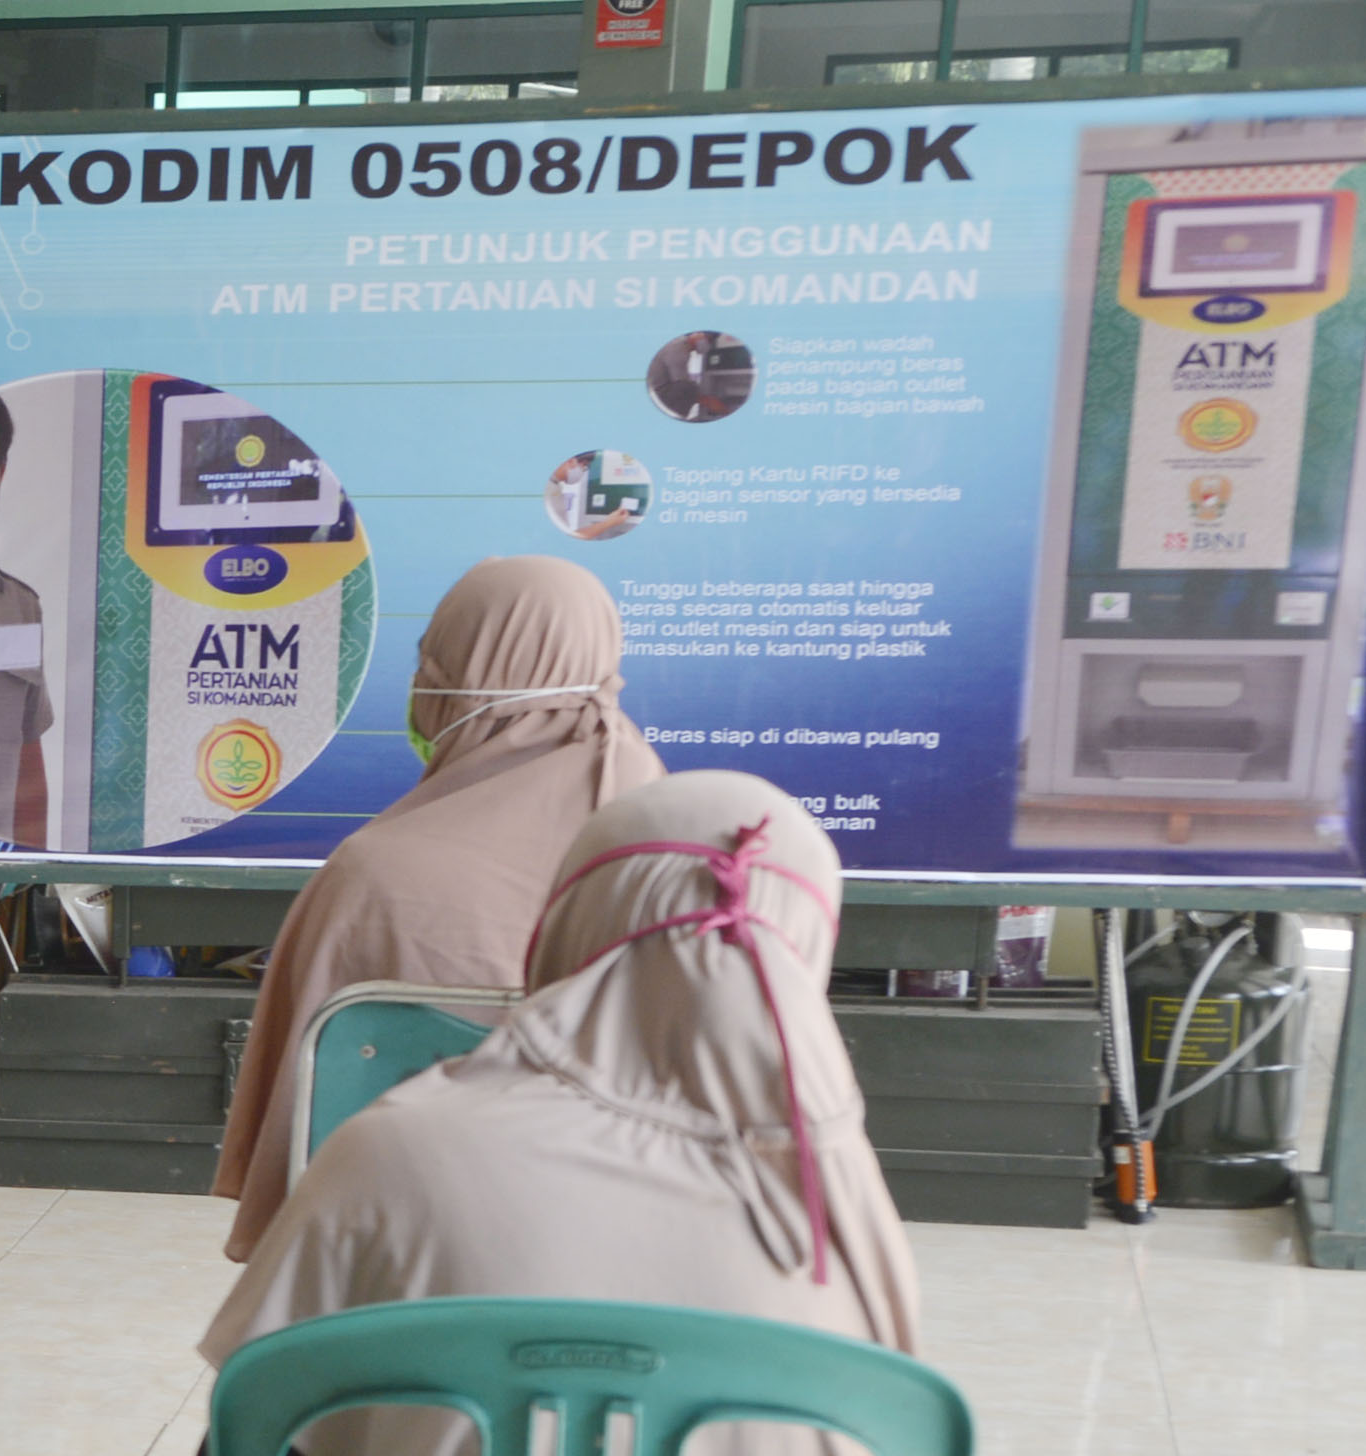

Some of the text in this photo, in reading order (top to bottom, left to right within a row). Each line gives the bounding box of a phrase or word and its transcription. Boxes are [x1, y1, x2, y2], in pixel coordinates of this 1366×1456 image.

[0, 123, 980, 206] KODIM 0508/DEPOK
[345, 219, 993, 266] PETUNJUK PENGGUNAAN
[210, 268, 979, 315] ATM PERTANIAN SI KOMANDAN
[770, 335, 935, 356] Siapkan wadah
[1177, 341, 1277, 369] ATM
[766, 355, 965, 376] penampung beras
[765, 375, 967, 397] pada bagian outlet
[764, 396, 985, 418] mesin bagian bawah
[664, 465, 901, 486] Tapping Kartu RIFD ke
[661, 484, 962, 507] bagian sensor yang tersedia
[659, 507, 748, 523] di mesin
[1192, 532, 1247, 549] BNI
[221, 557, 269, 577] ELBO
[620, 579, 935, 599] Tunggu beberapa saat hingga
[619, 600, 923, 616] beras secara otomatis keluar
[661, 620, 721, 637] outlet
[725, 620, 788, 637] mesin
[795, 620, 836, 637] dan
[840, 620, 886, 641] siap
[890, 620, 952, 637] untuk
[189, 624, 300, 670] ATM
[735, 640, 760, 657] ke
[766, 640, 851, 661] kantung
[856, 640, 927, 661] plastik
[187, 671, 298, 690] PERTANIAN
[187, 691, 297, 707] SI KOMANDAN
[644, 726, 940, 749] Beras siap di dibawa pulang
[834, 794, 881, 811] bulk
